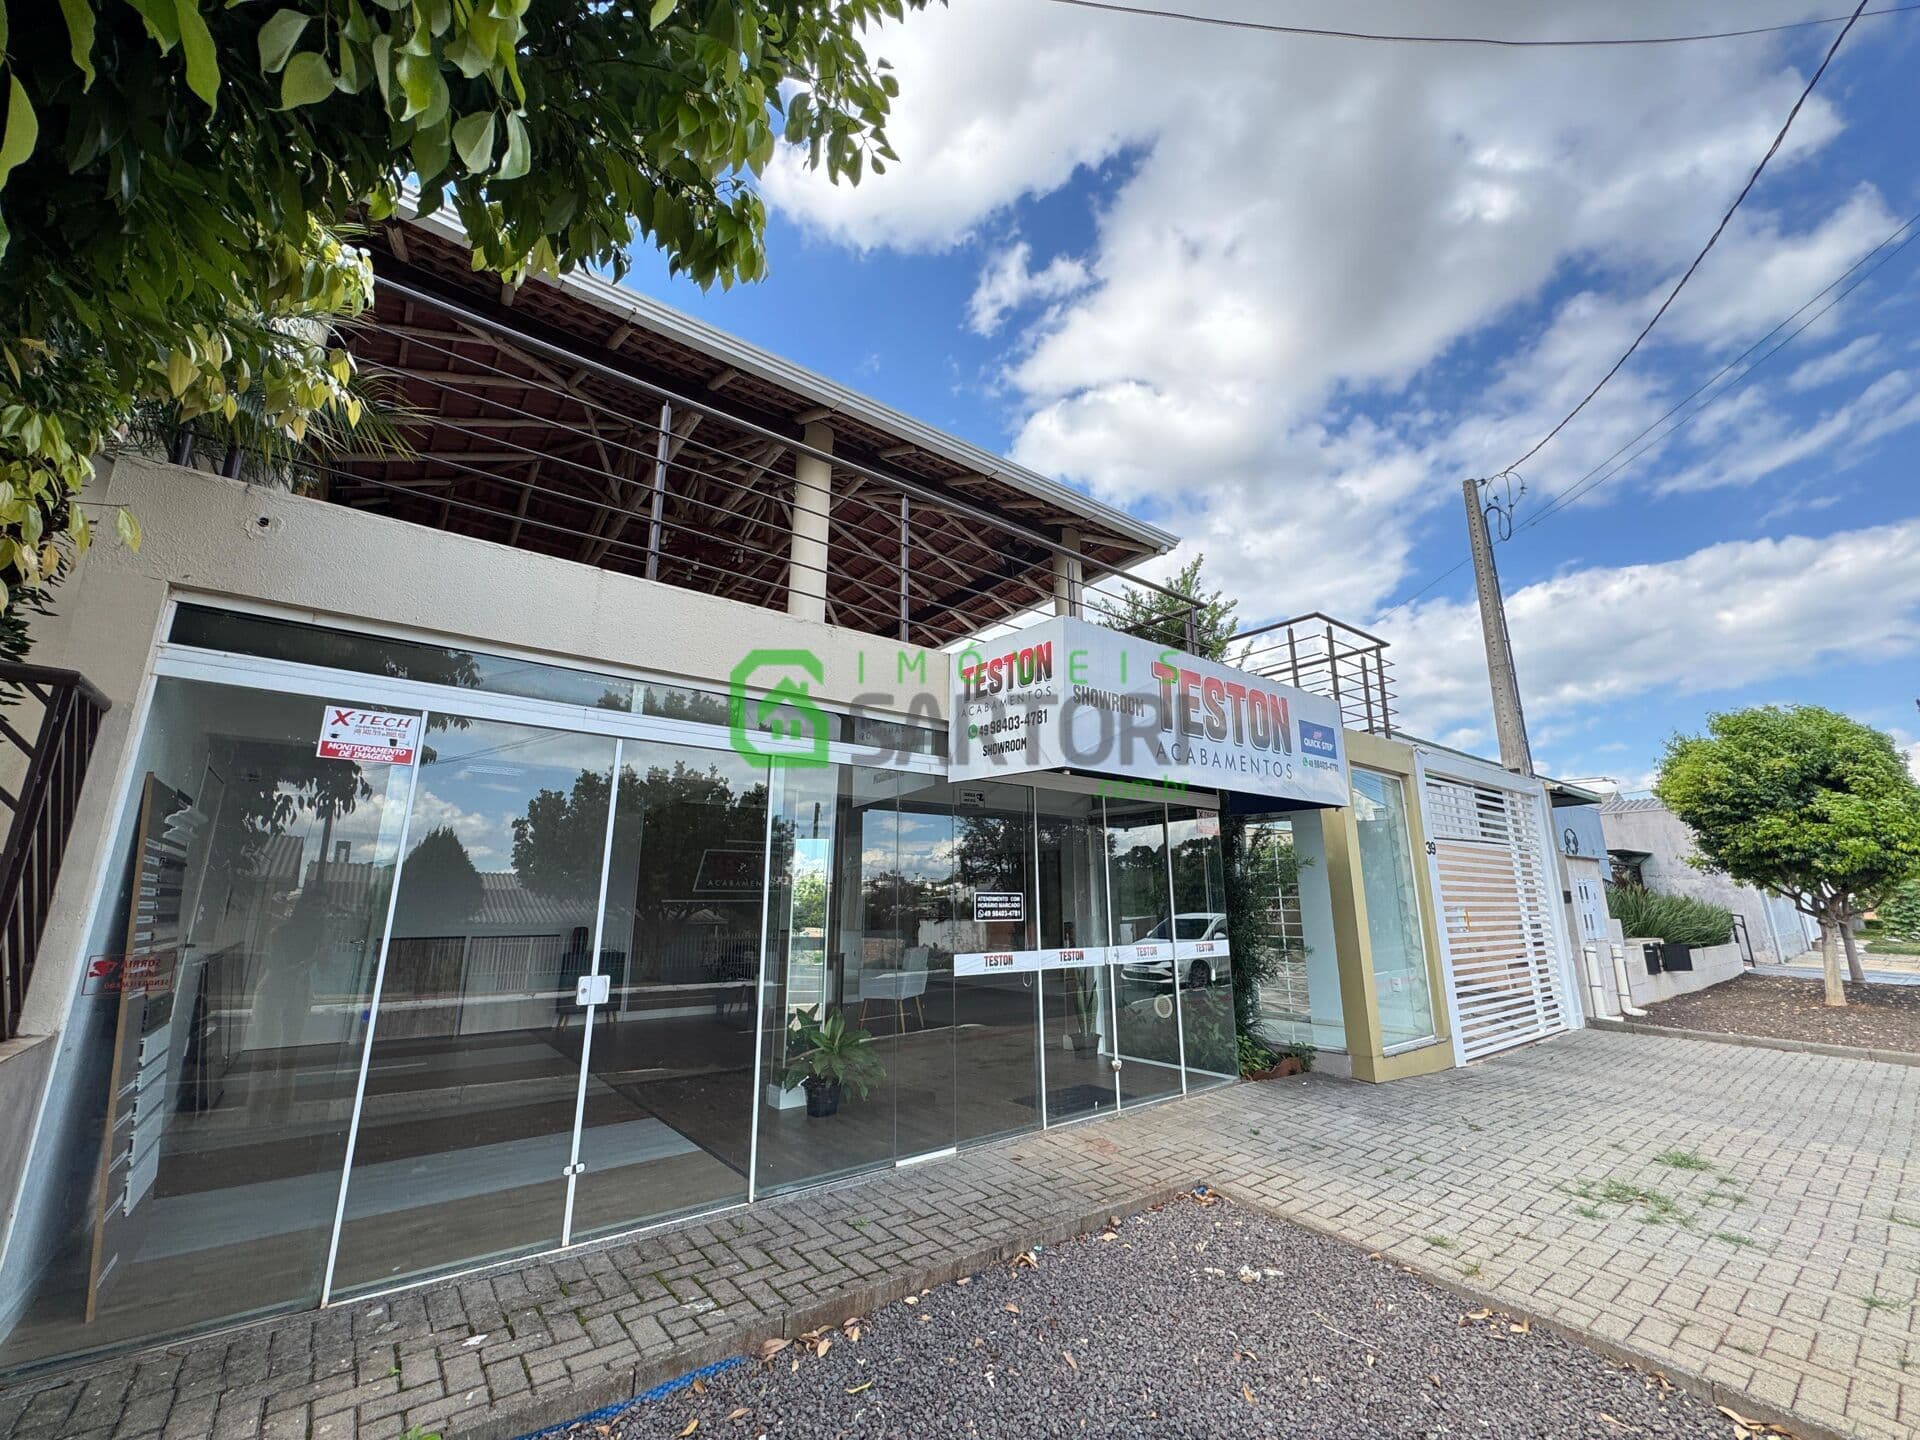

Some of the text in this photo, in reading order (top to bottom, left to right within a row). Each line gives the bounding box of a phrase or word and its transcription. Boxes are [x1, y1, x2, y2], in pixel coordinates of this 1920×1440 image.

[961, 640, 1052, 703] TESTON
[961, 686, 1052, 718] ACABAMENTOS
[1073, 684, 1145, 717] SHOWROOM
[1152, 661, 1292, 756] TESTON
[979, 709, 1048, 736] 49 98403-4781
[327, 742, 406, 756] MONITORAMENTO
[338, 750, 394, 761] DE IMAGENS
[983, 738, 1027, 757] SHOWROOM
[1156, 742, 1293, 779] ACABAMENTOS
[1425, 841, 1436, 855] 39
[1136, 946, 1158, 957] TESTON
[1195, 943, 1214, 952] TESTON
[984, 955, 1013, 967] TESTON
[1058, 951, 1084, 962] TESTON
